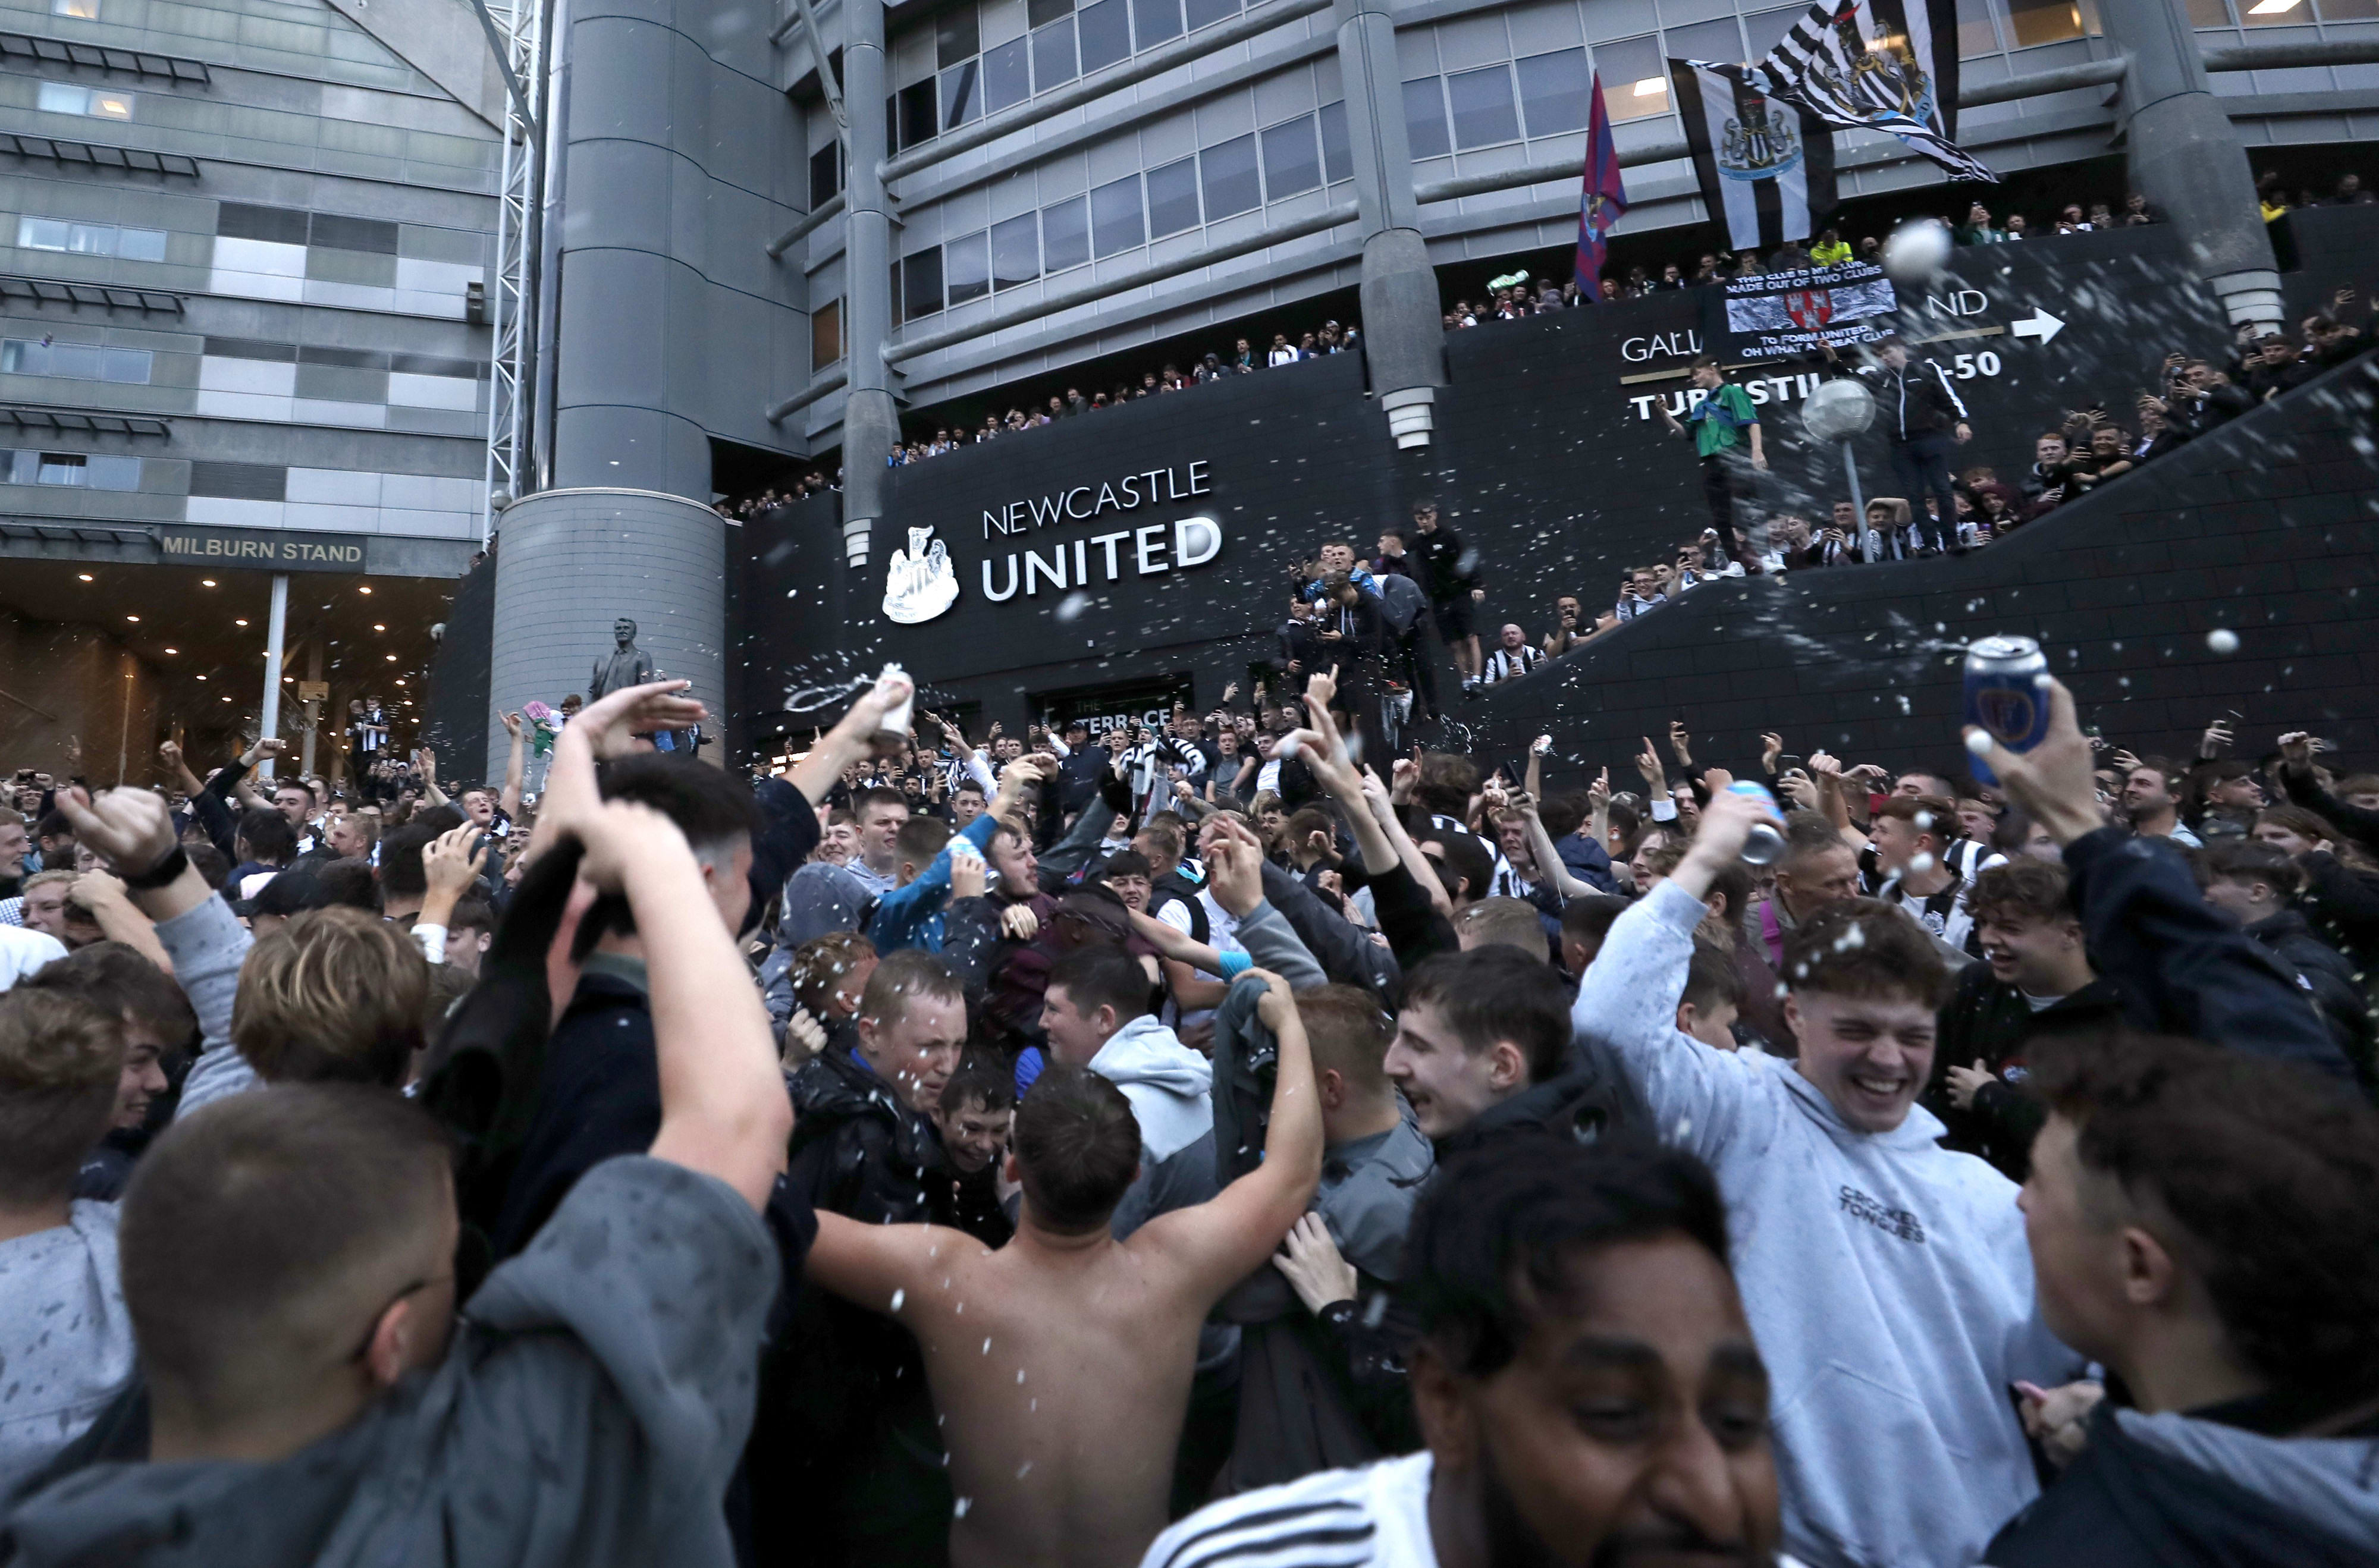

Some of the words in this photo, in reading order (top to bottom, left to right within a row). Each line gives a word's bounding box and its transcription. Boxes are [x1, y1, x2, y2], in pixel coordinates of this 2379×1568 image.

[1725, 282, 1764, 294] MADE
[1766, 279, 1791, 290] OUT
[1792, 277, 1811, 287] OF
[1812, 273, 1843, 285] TWO
[1844, 265, 1883, 280] CLUBS
[1735, 276, 1765, 284] THIS
[1766, 271, 1796, 280] CLUB
[1811, 266, 1829, 275] MY
[1927, 290, 1988, 319] ND
[1741, 347, 1763, 357] OH
[1765, 343, 1803, 356] WHAT
[1805, 342, 1816, 351] A
[1827, 336, 1861, 348] REAT
[1759, 336, 1778, 345] TO
[1780, 331, 1819, 345] FORM
[983, 460, 1211, 540] NEWCASTLE
[162, 536, 275, 559] MILBURN
[282, 542, 362, 563] STAND
[982, 516, 1222, 602] UNITED
[1075, 700, 1100, 712] THE
[1075, 708, 1170, 735] TERRCE
